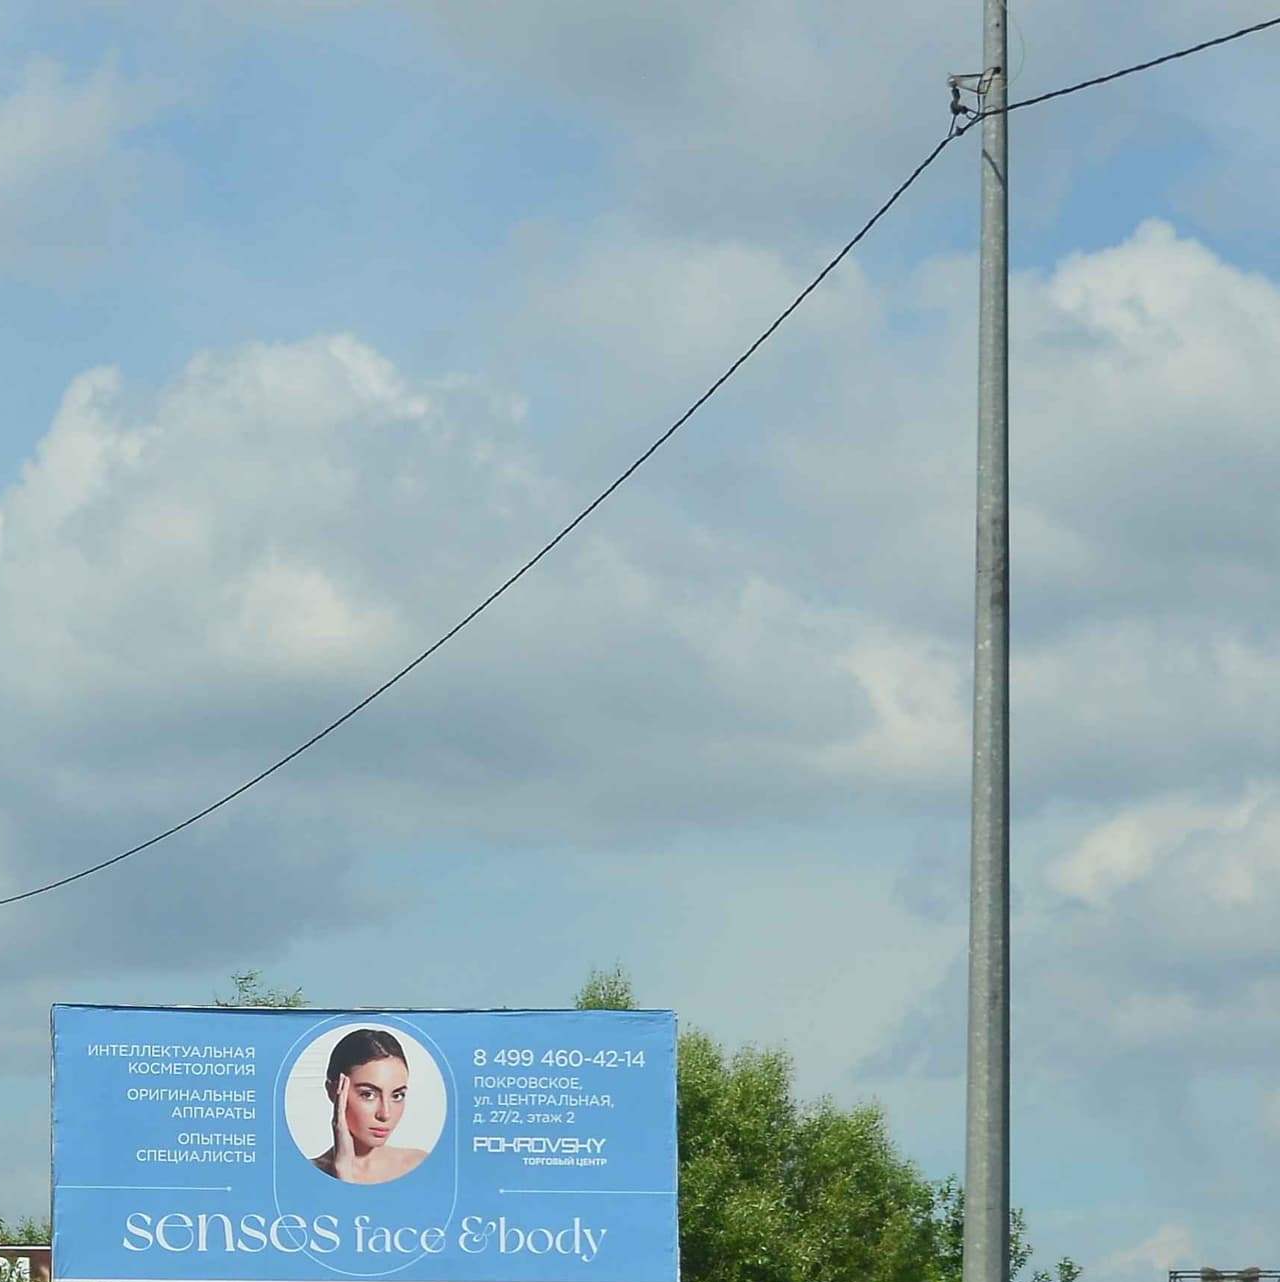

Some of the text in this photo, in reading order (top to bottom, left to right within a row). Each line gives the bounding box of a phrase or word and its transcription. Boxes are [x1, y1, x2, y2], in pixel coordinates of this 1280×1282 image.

[87, 1044, 256, 1059] ИНТЕЛЛЕКТУАЛЬНАЯ
[473, 1049, 646, 1068] 8 499 460-42-14
[128, 1062, 256, 1076] КОСМЕТОЛОГИЯ
[474, 1076, 583, 1091] ПОКРОВСКОЕ,
[127, 1088, 256, 1102] ОРИГИНАЛЬНЫЕ
[474, 1094, 615, 1108] ул. ЦЕНТРАЛЬНАЯ,
[171, 1106, 256, 1120] АППАРАТЫ
[473, 1110, 575, 1125] д. 27/2, этаж 2
[177, 1132, 256, 1146] ОПЫТНЫЕ
[136, 1149, 256, 1164] СПЕЦИАЛИСТЫ
[523, 1157, 607, 1167] ТОРГОВЫЙ ЦЕНТР
[122, 1212, 340, 1253] senses
[353, 1215, 446, 1254] face
